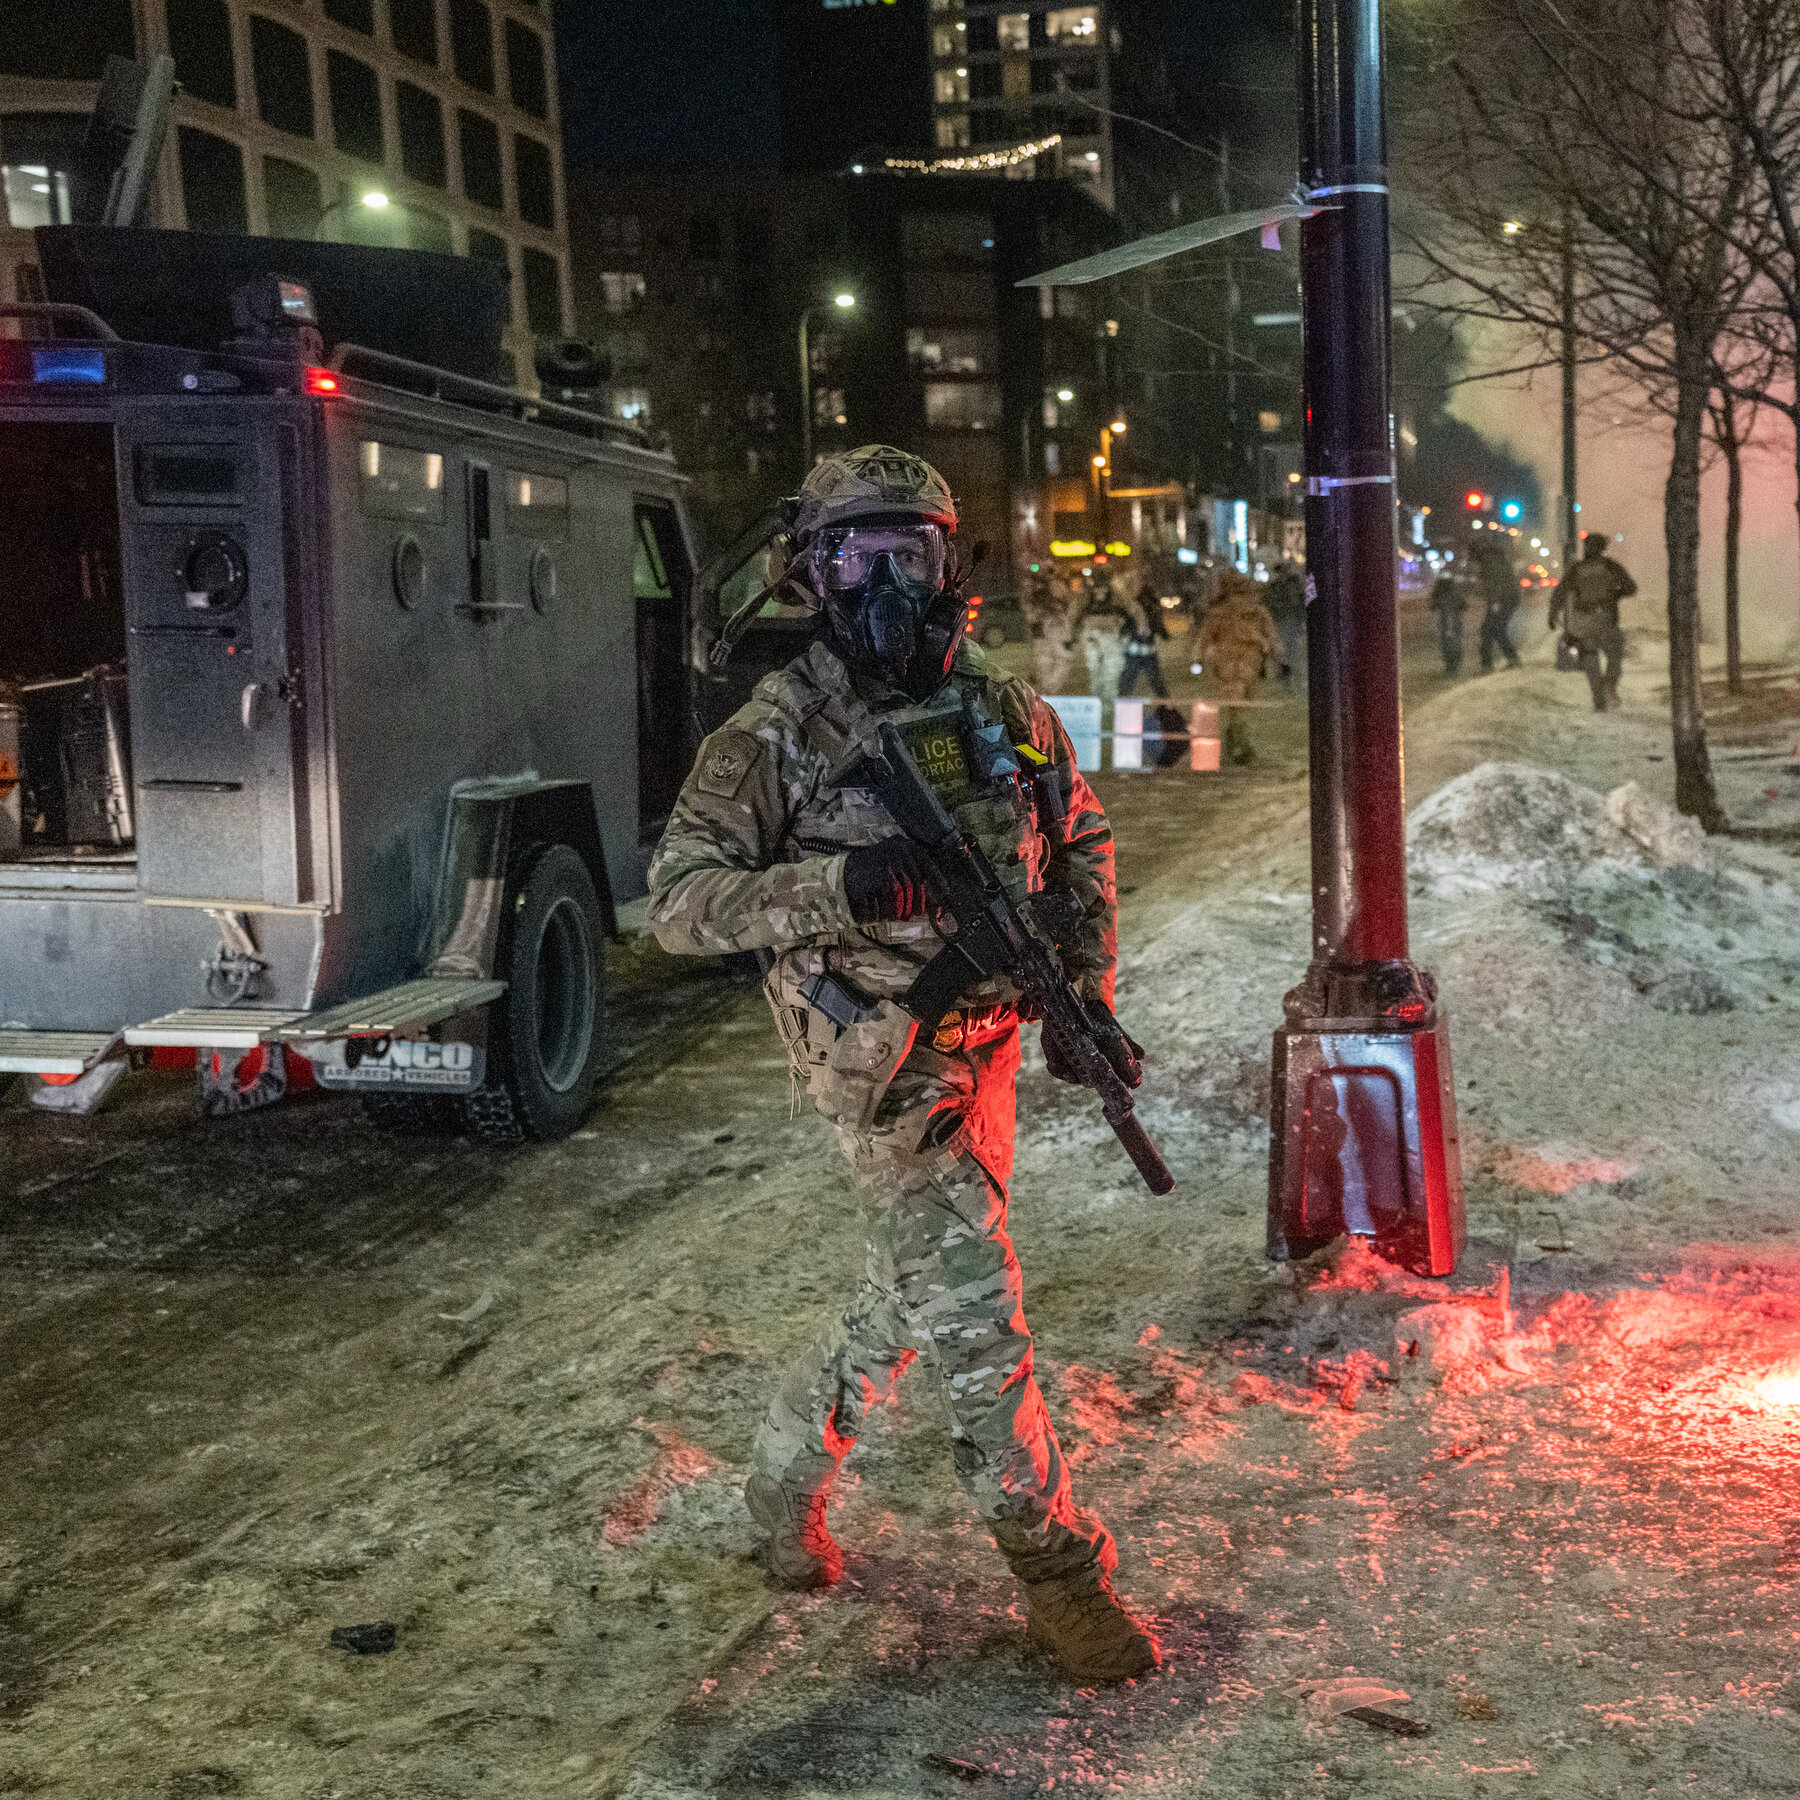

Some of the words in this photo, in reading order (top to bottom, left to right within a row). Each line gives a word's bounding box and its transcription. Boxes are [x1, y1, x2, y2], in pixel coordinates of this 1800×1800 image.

[911, 736, 960, 763] LICE
[920, 757, 965, 778] ORTAC
[356, 1040, 473, 1069] NCO
[406, 1070, 469, 1083] VEHICLES
